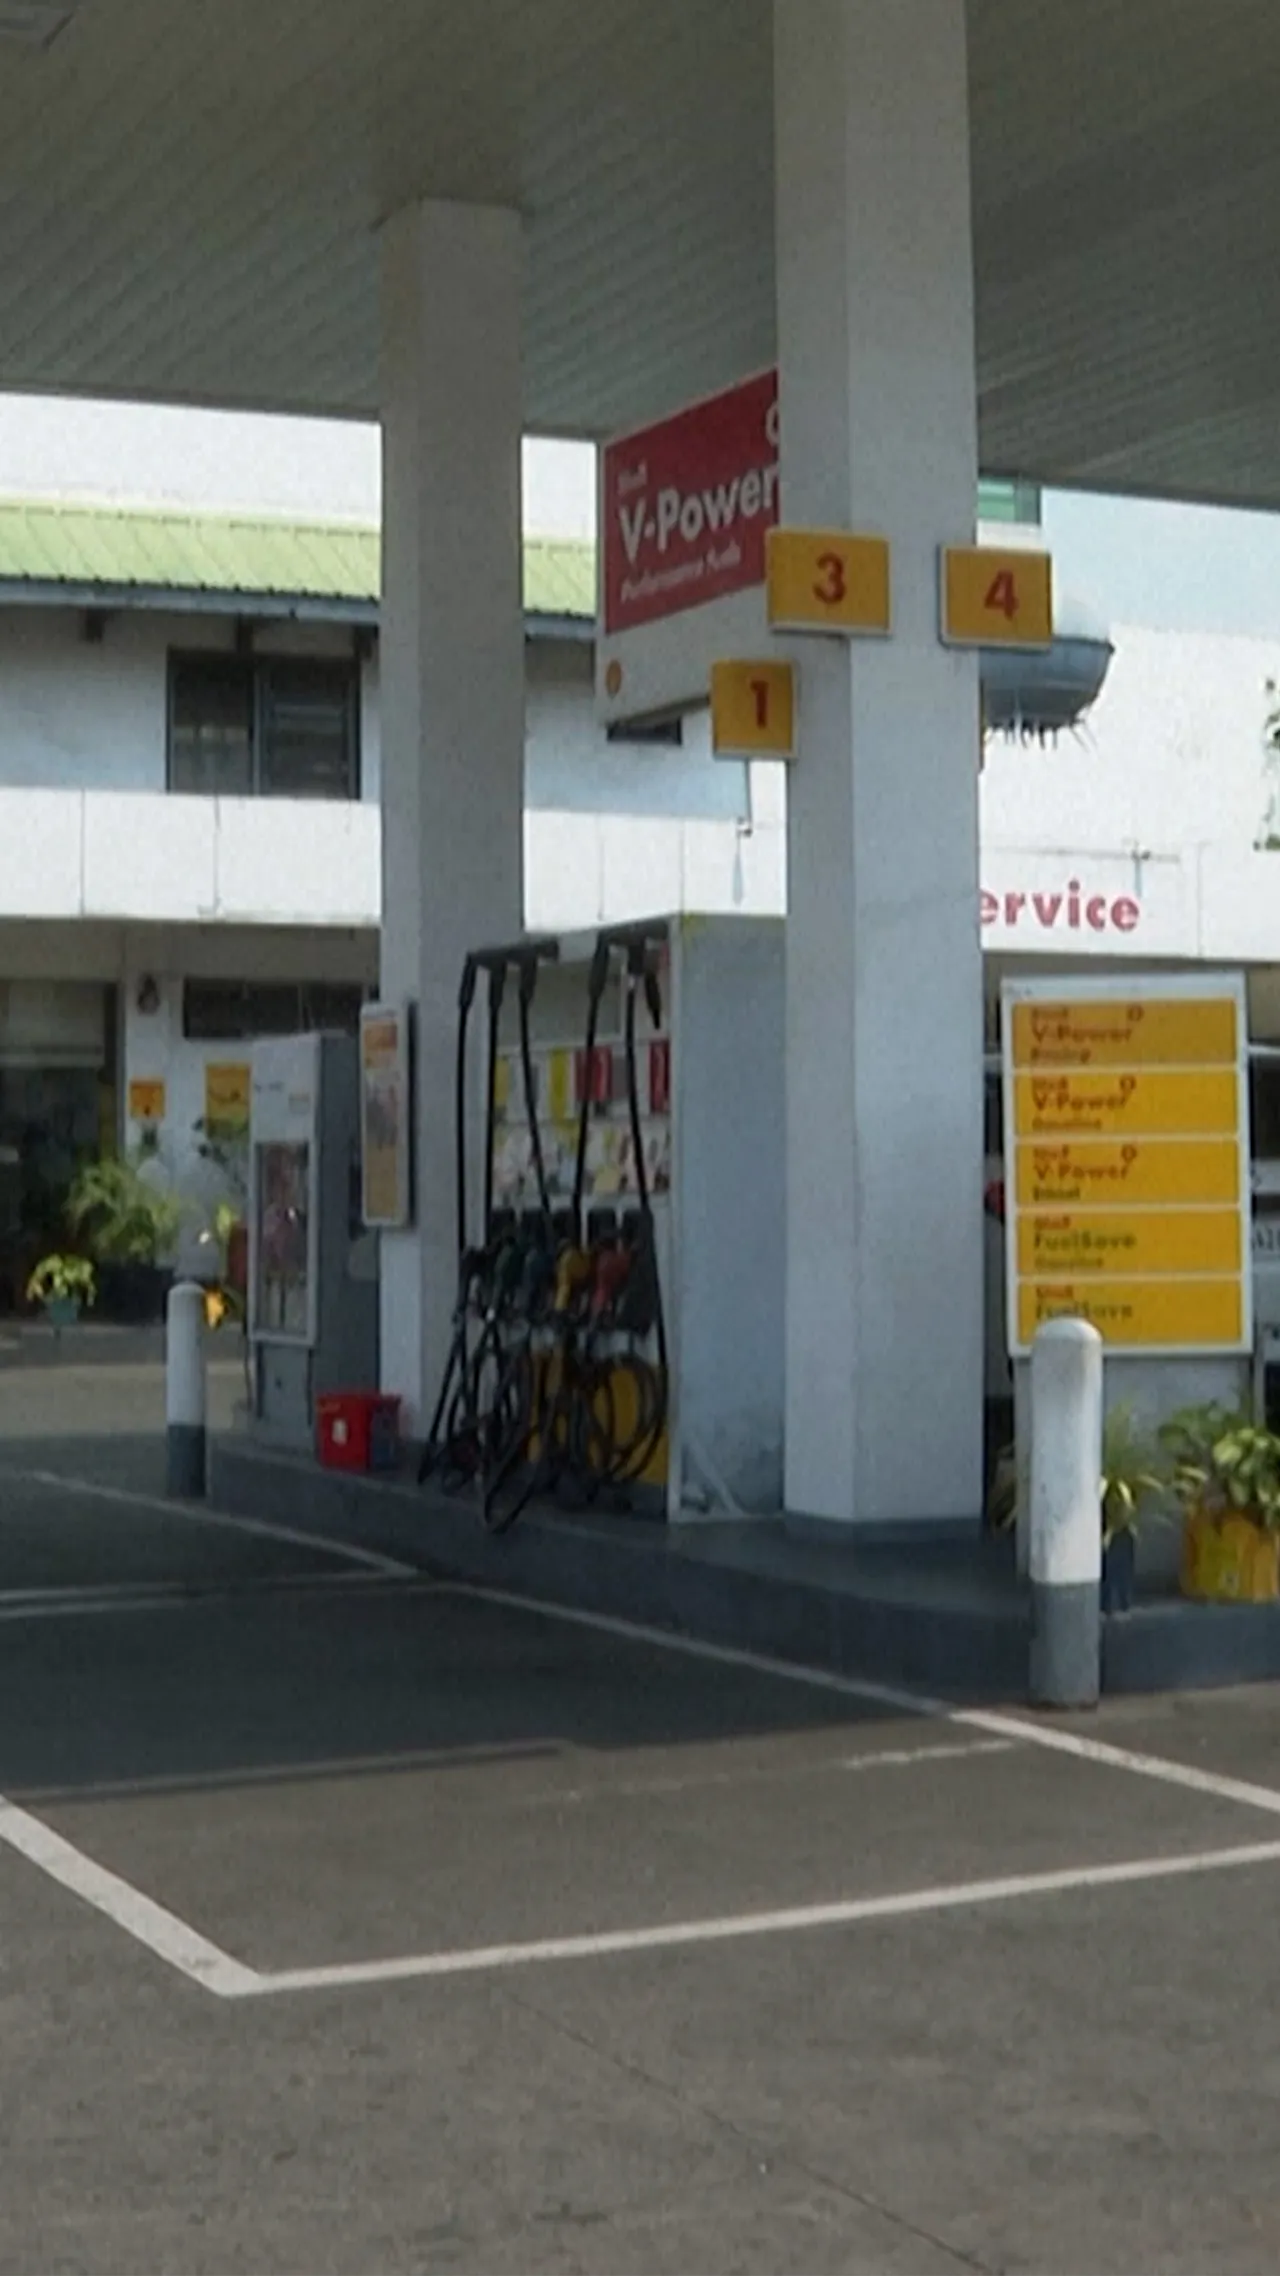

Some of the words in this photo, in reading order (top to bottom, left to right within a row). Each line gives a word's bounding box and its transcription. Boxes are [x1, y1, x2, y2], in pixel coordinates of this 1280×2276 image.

[619, 463, 779, 566] V-Power
[812, 552, 846, 604] 3
[984, 568, 1020, 621] 4
[749, 679, 769, 728] 1
